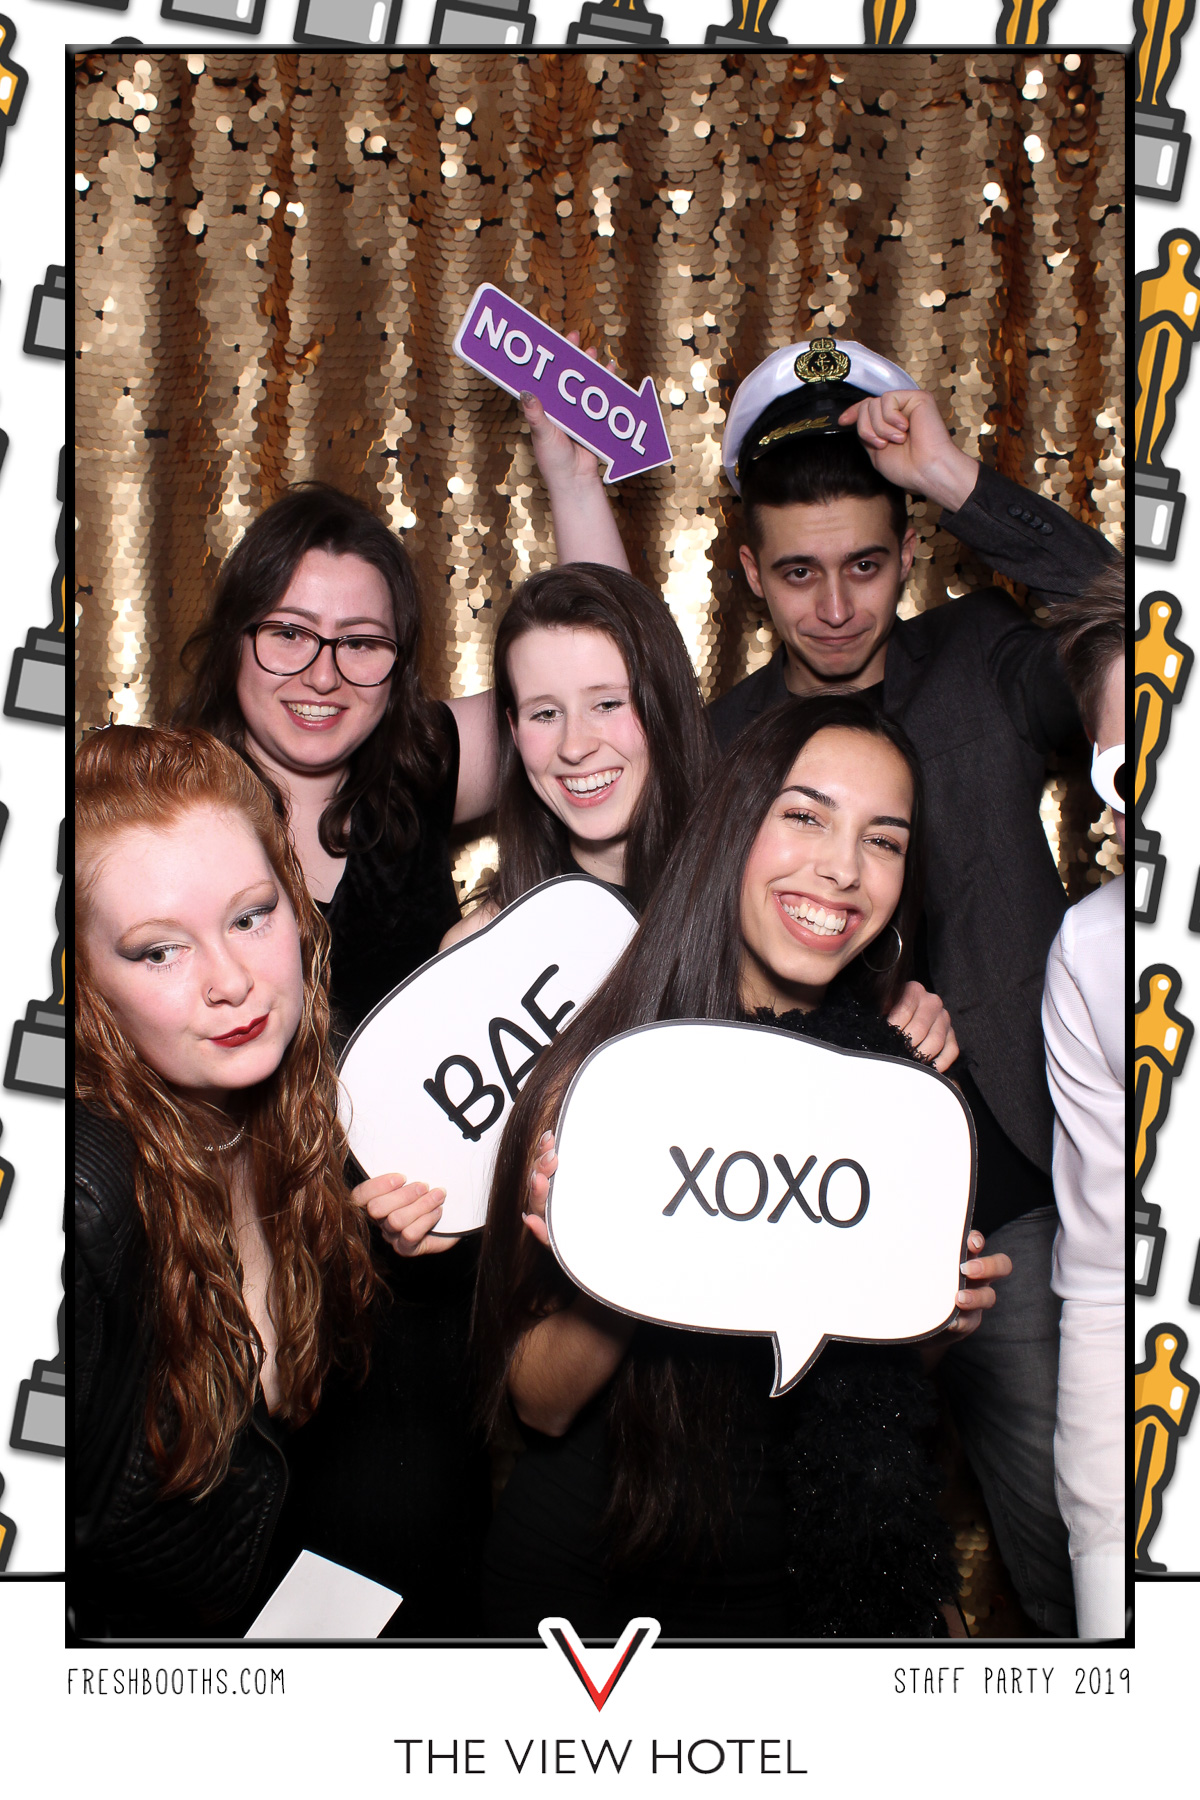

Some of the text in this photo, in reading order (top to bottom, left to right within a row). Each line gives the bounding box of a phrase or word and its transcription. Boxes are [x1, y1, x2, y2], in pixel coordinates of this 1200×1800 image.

[473, 305, 648, 456] NOT COOL
[662, 1145, 871, 1229] XOXO
